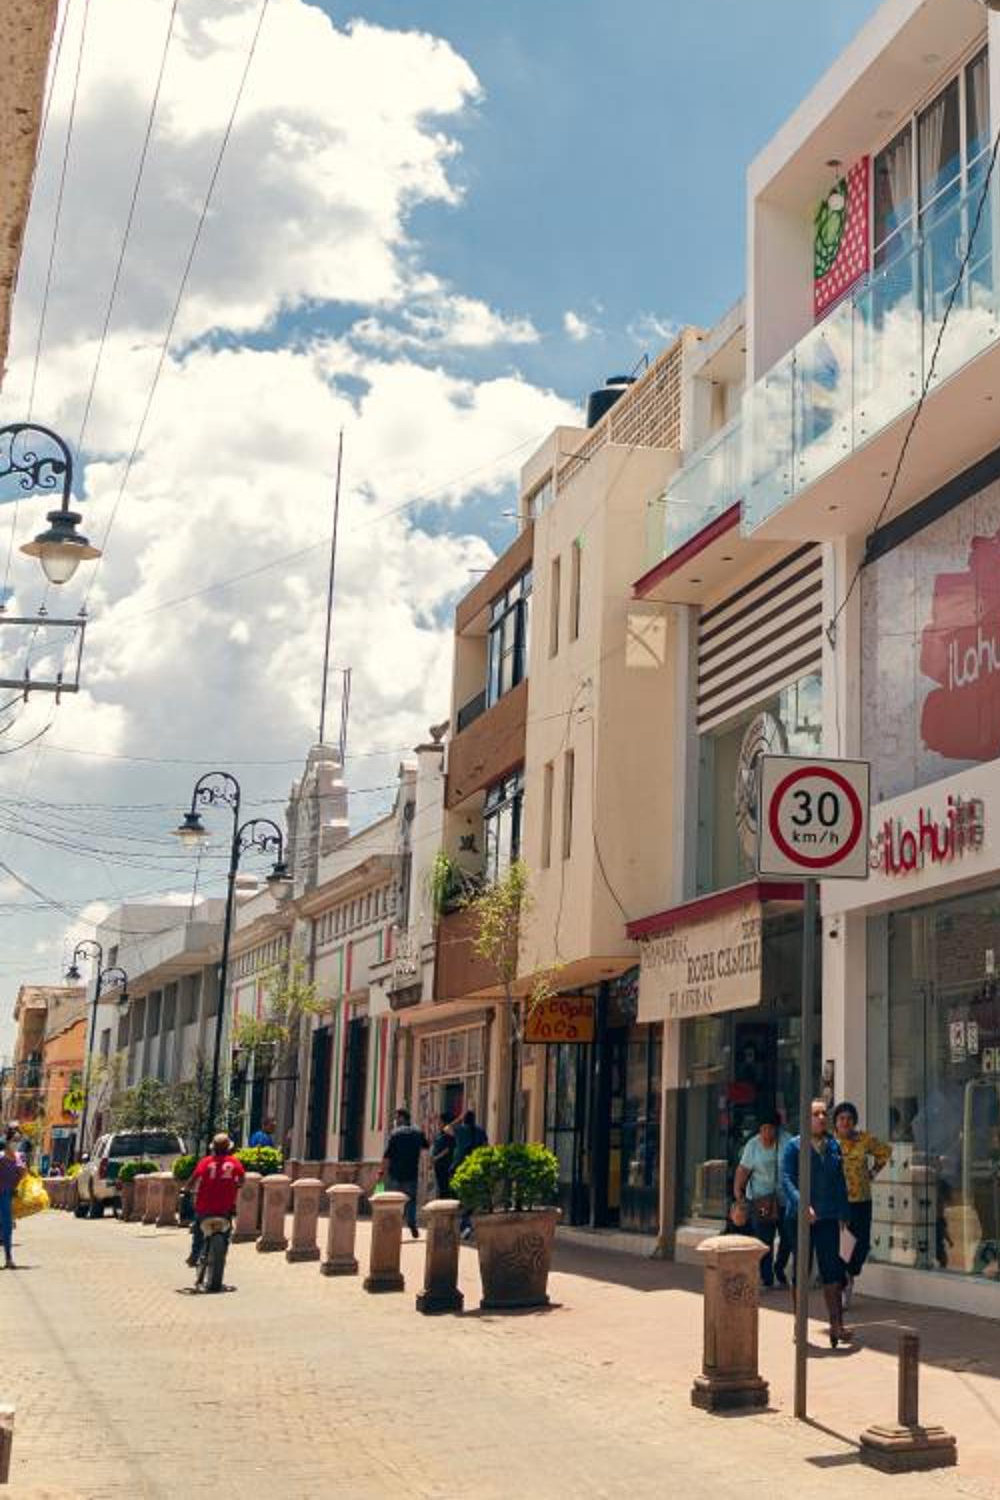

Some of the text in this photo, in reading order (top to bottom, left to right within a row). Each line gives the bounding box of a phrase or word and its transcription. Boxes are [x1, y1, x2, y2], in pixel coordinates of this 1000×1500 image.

[791, 790, 840, 827] 30
[792, 830, 839, 844] km/h
[687, 951, 716, 985] ROPA
